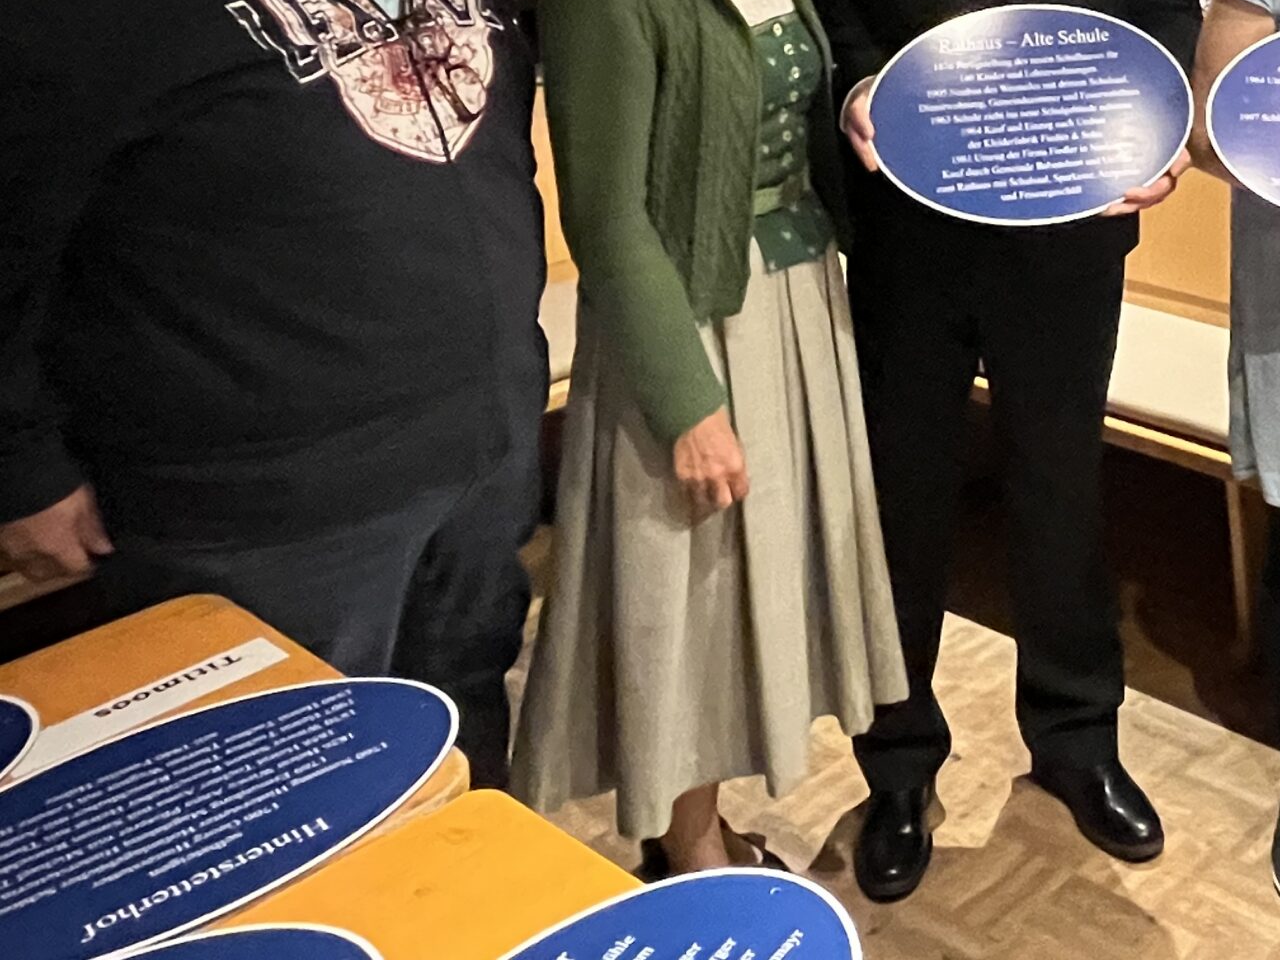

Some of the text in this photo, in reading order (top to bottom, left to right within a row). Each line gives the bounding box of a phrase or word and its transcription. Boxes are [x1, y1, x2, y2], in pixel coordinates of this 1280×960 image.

[1021, 32, 1053, 48] Alte
[1058, 27, 1110, 45] Schule
[942, 167, 964, 179] Kauf
[93, 655, 242, 717] Titlmoos
[80, 817, 330, 943] Hinterstetterhof
